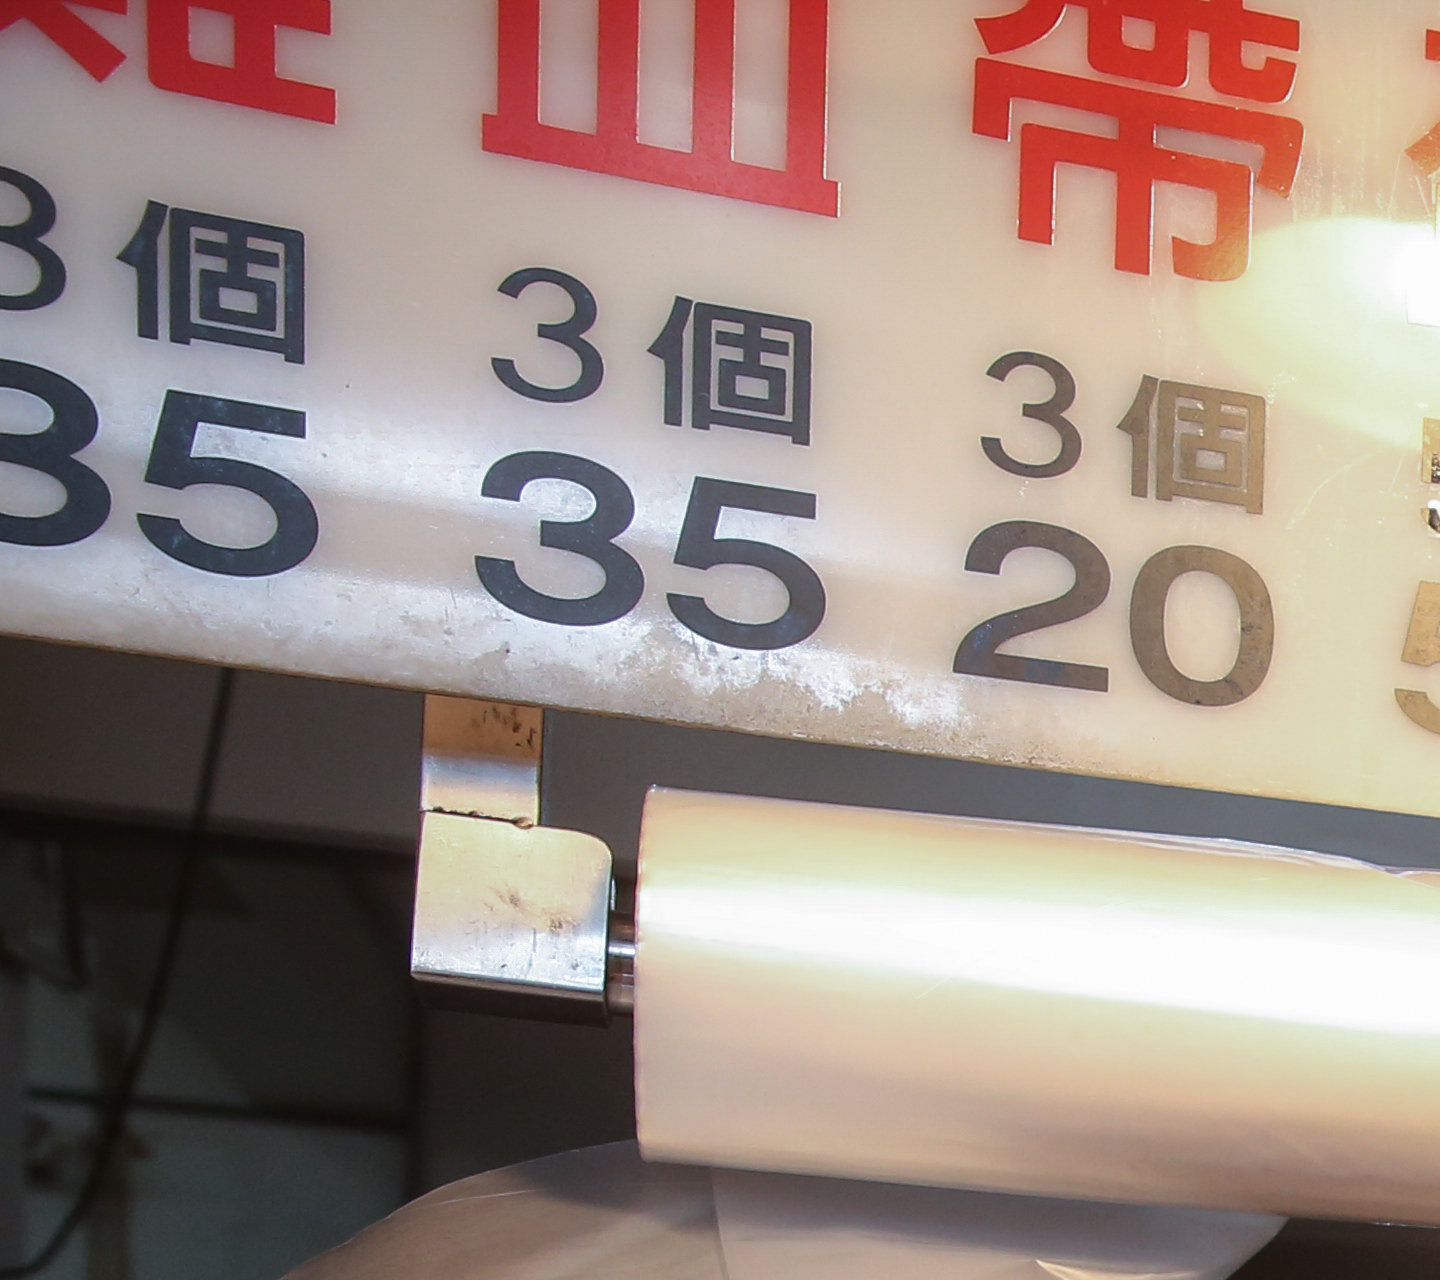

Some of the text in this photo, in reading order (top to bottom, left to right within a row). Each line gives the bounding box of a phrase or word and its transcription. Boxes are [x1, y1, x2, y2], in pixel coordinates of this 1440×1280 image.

[490, 267, 813, 446] 3個
[979, 350, 1267, 515] 3個
[475, 450, 826, 650] 35
[952, 520, 1275, 707] 20
